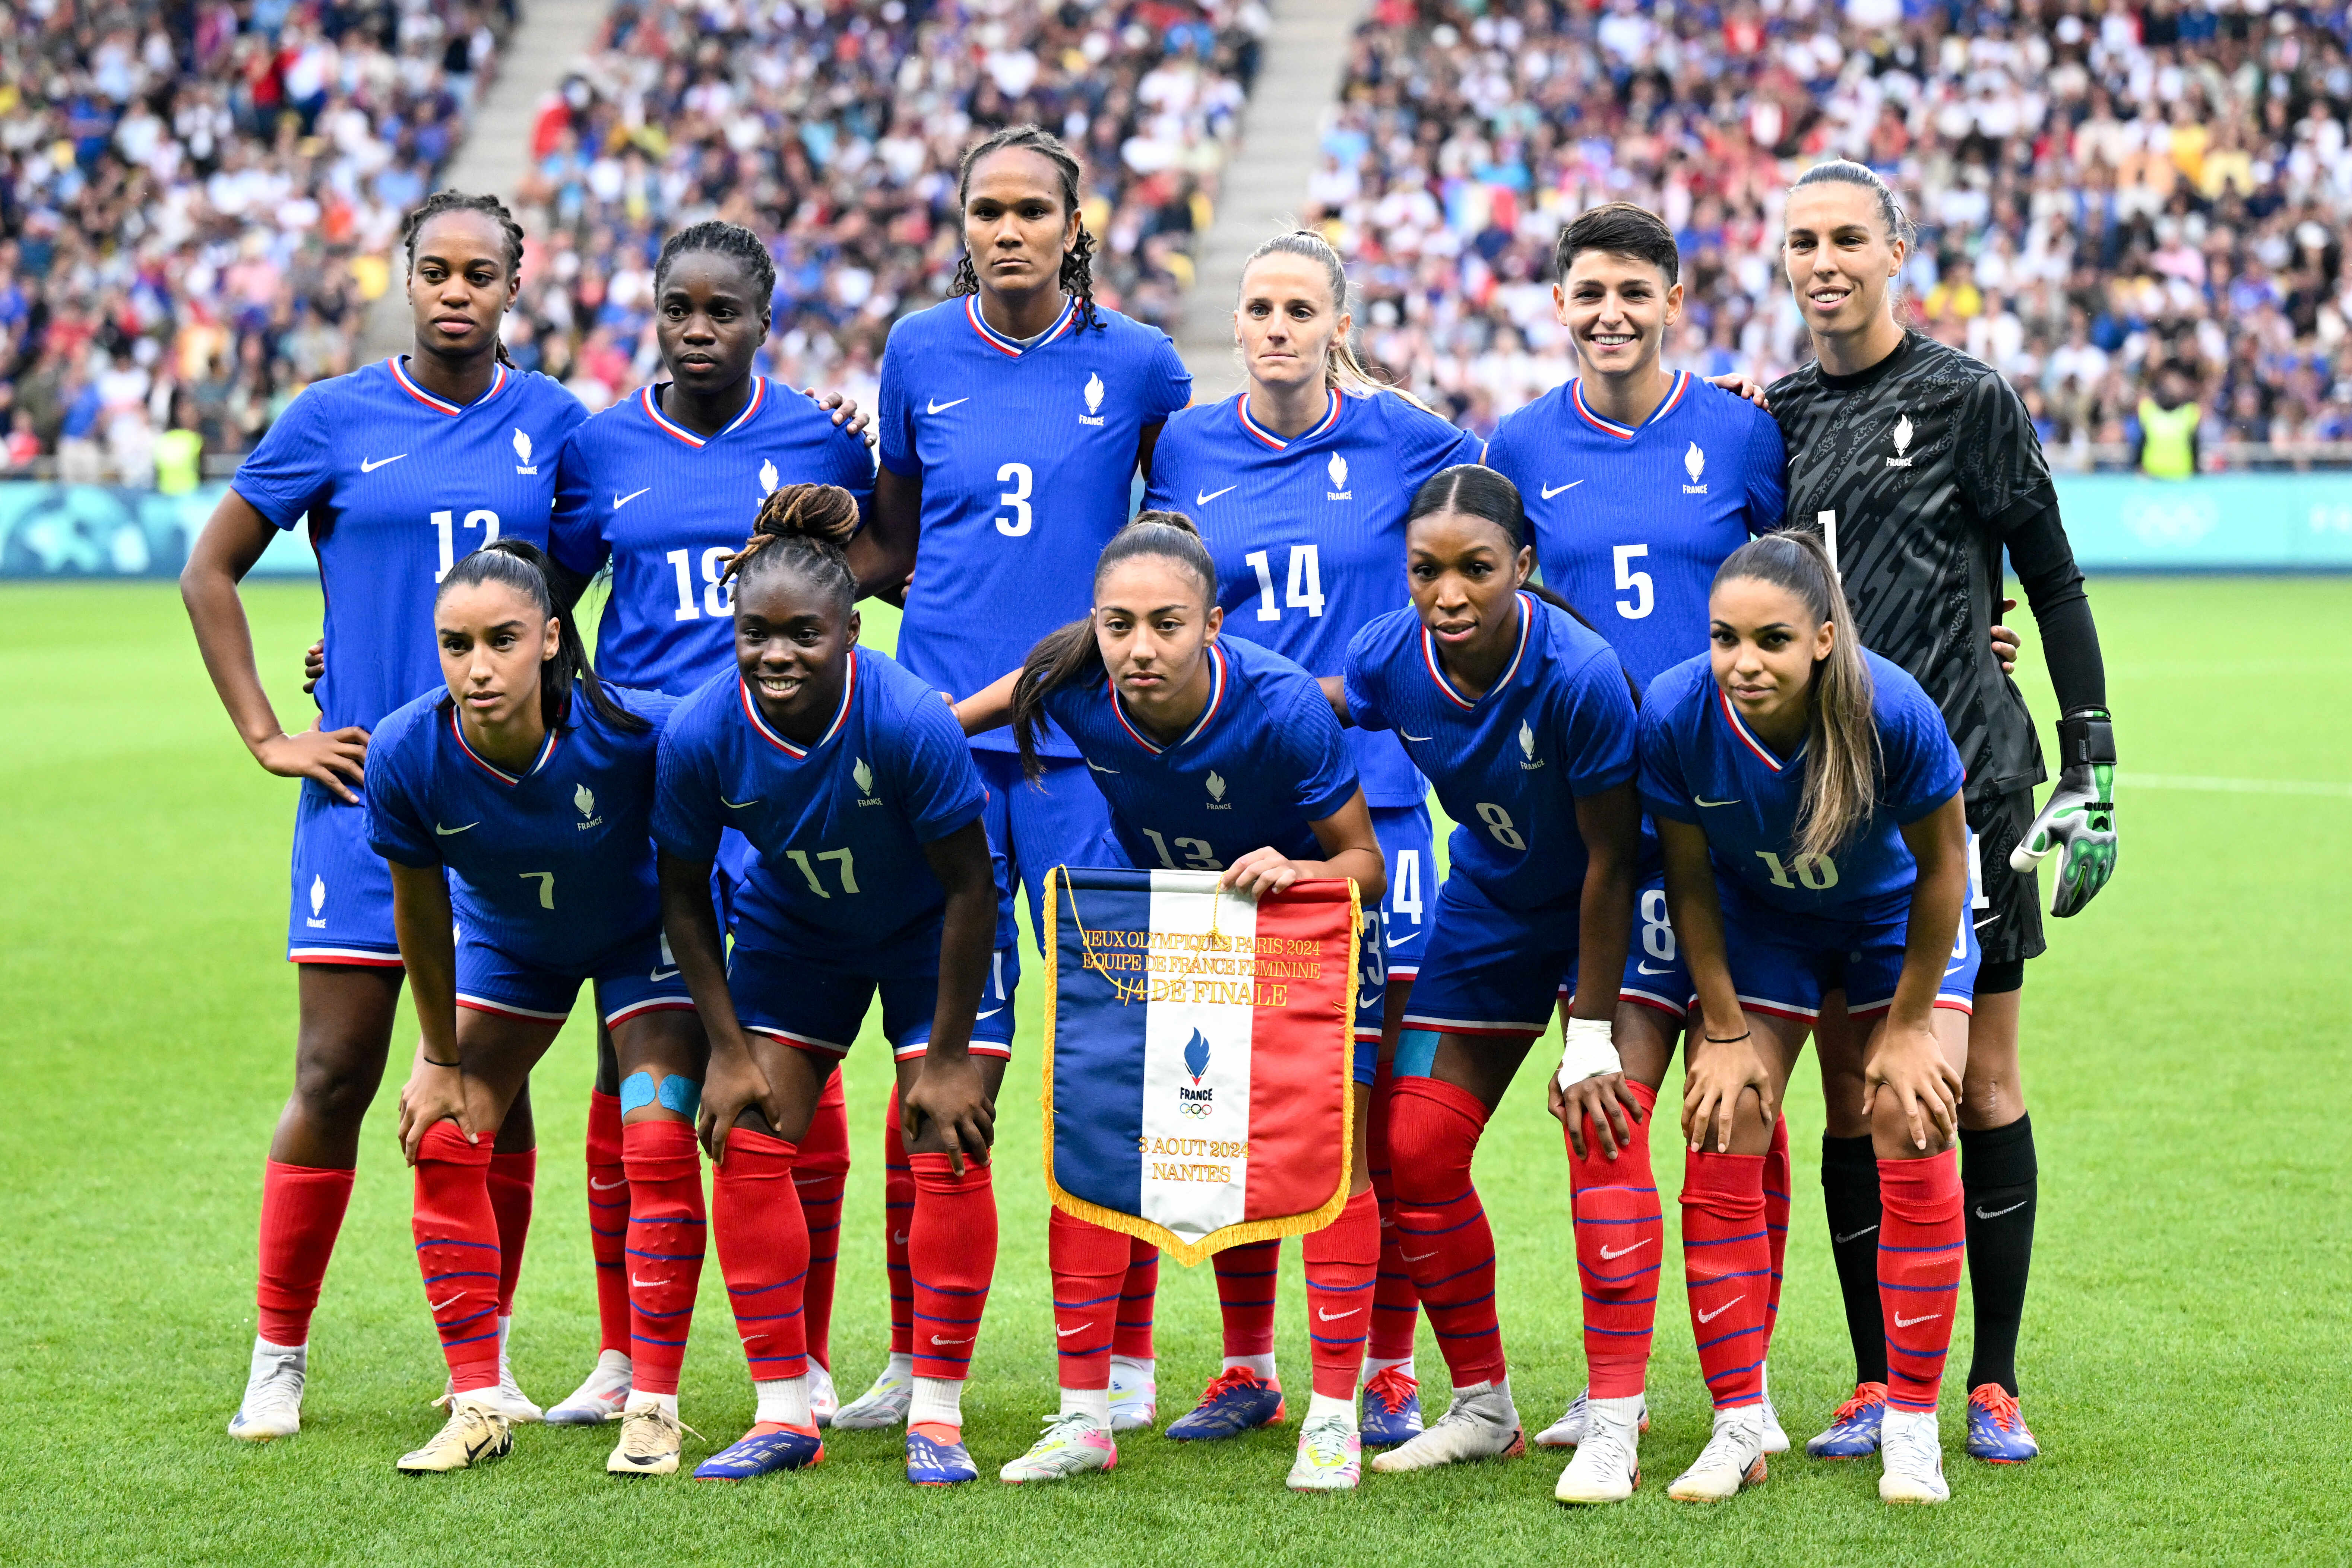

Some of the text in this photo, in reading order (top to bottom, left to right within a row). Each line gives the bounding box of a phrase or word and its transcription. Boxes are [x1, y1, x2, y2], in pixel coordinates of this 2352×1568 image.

[1079, 415, 1104, 426] FRANCE
[516, 465, 537, 475] FRANCE
[1886, 456, 1912, 467] FRANCE
[995, 463, 1032, 537] 3
[1327, 490, 1352, 500] FRANCE
[1683, 484, 1707, 494] FRANCE
[667, 547, 738, 621] 18
[1245, 544, 1325, 621] 14
[1613, 544, 1654, 619] 5
[1520, 758, 1545, 770] FRANCE
[857, 798, 883, 808] FRANCE
[577, 815, 603, 831] FRANCE
[1475, 802, 1526, 850] 8
[1142, 828, 1224, 870] 13
[786, 847, 860, 898] 17
[1755, 850, 1839, 889] 10
[519, 872, 555, 910] 7
[307, 917, 326, 929] FRANCE
[1640, 889, 1675, 961] 8
[1083, 931, 1320, 956] JEUX OLYMPIQUES PARIS 2024
[1082, 953, 1320, 979] EQUIPE DE FRANCE FEMININE
[1115, 978, 1287, 1007] 1/4 DE FINALE
[1180, 1087, 1213, 1101] FRANCE
[1139, 1137, 1250, 1158] 3 AOUT 2024
[1152, 1163, 1231, 1183] NANTES
